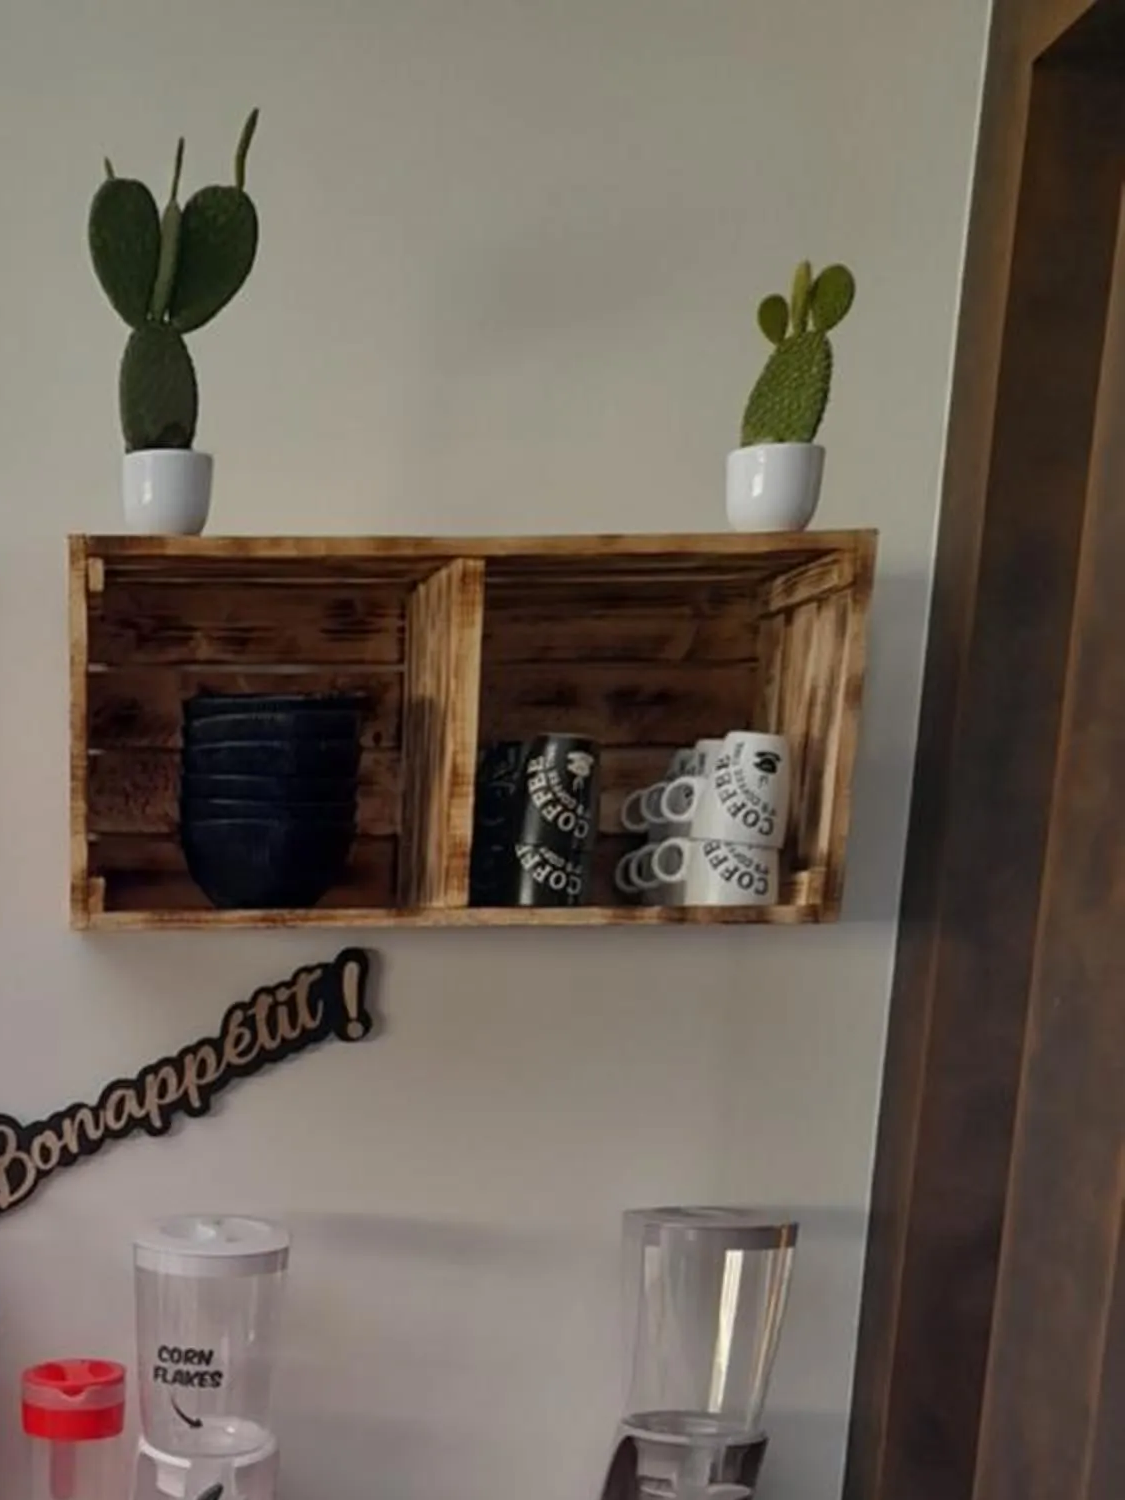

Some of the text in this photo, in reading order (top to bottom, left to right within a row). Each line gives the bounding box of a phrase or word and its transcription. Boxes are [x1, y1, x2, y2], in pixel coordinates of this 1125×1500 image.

[714, 755, 774, 836] COFFEE
[157, 1345, 214, 1366] CORN
[153, 1365, 223, 1389] FLAKES
